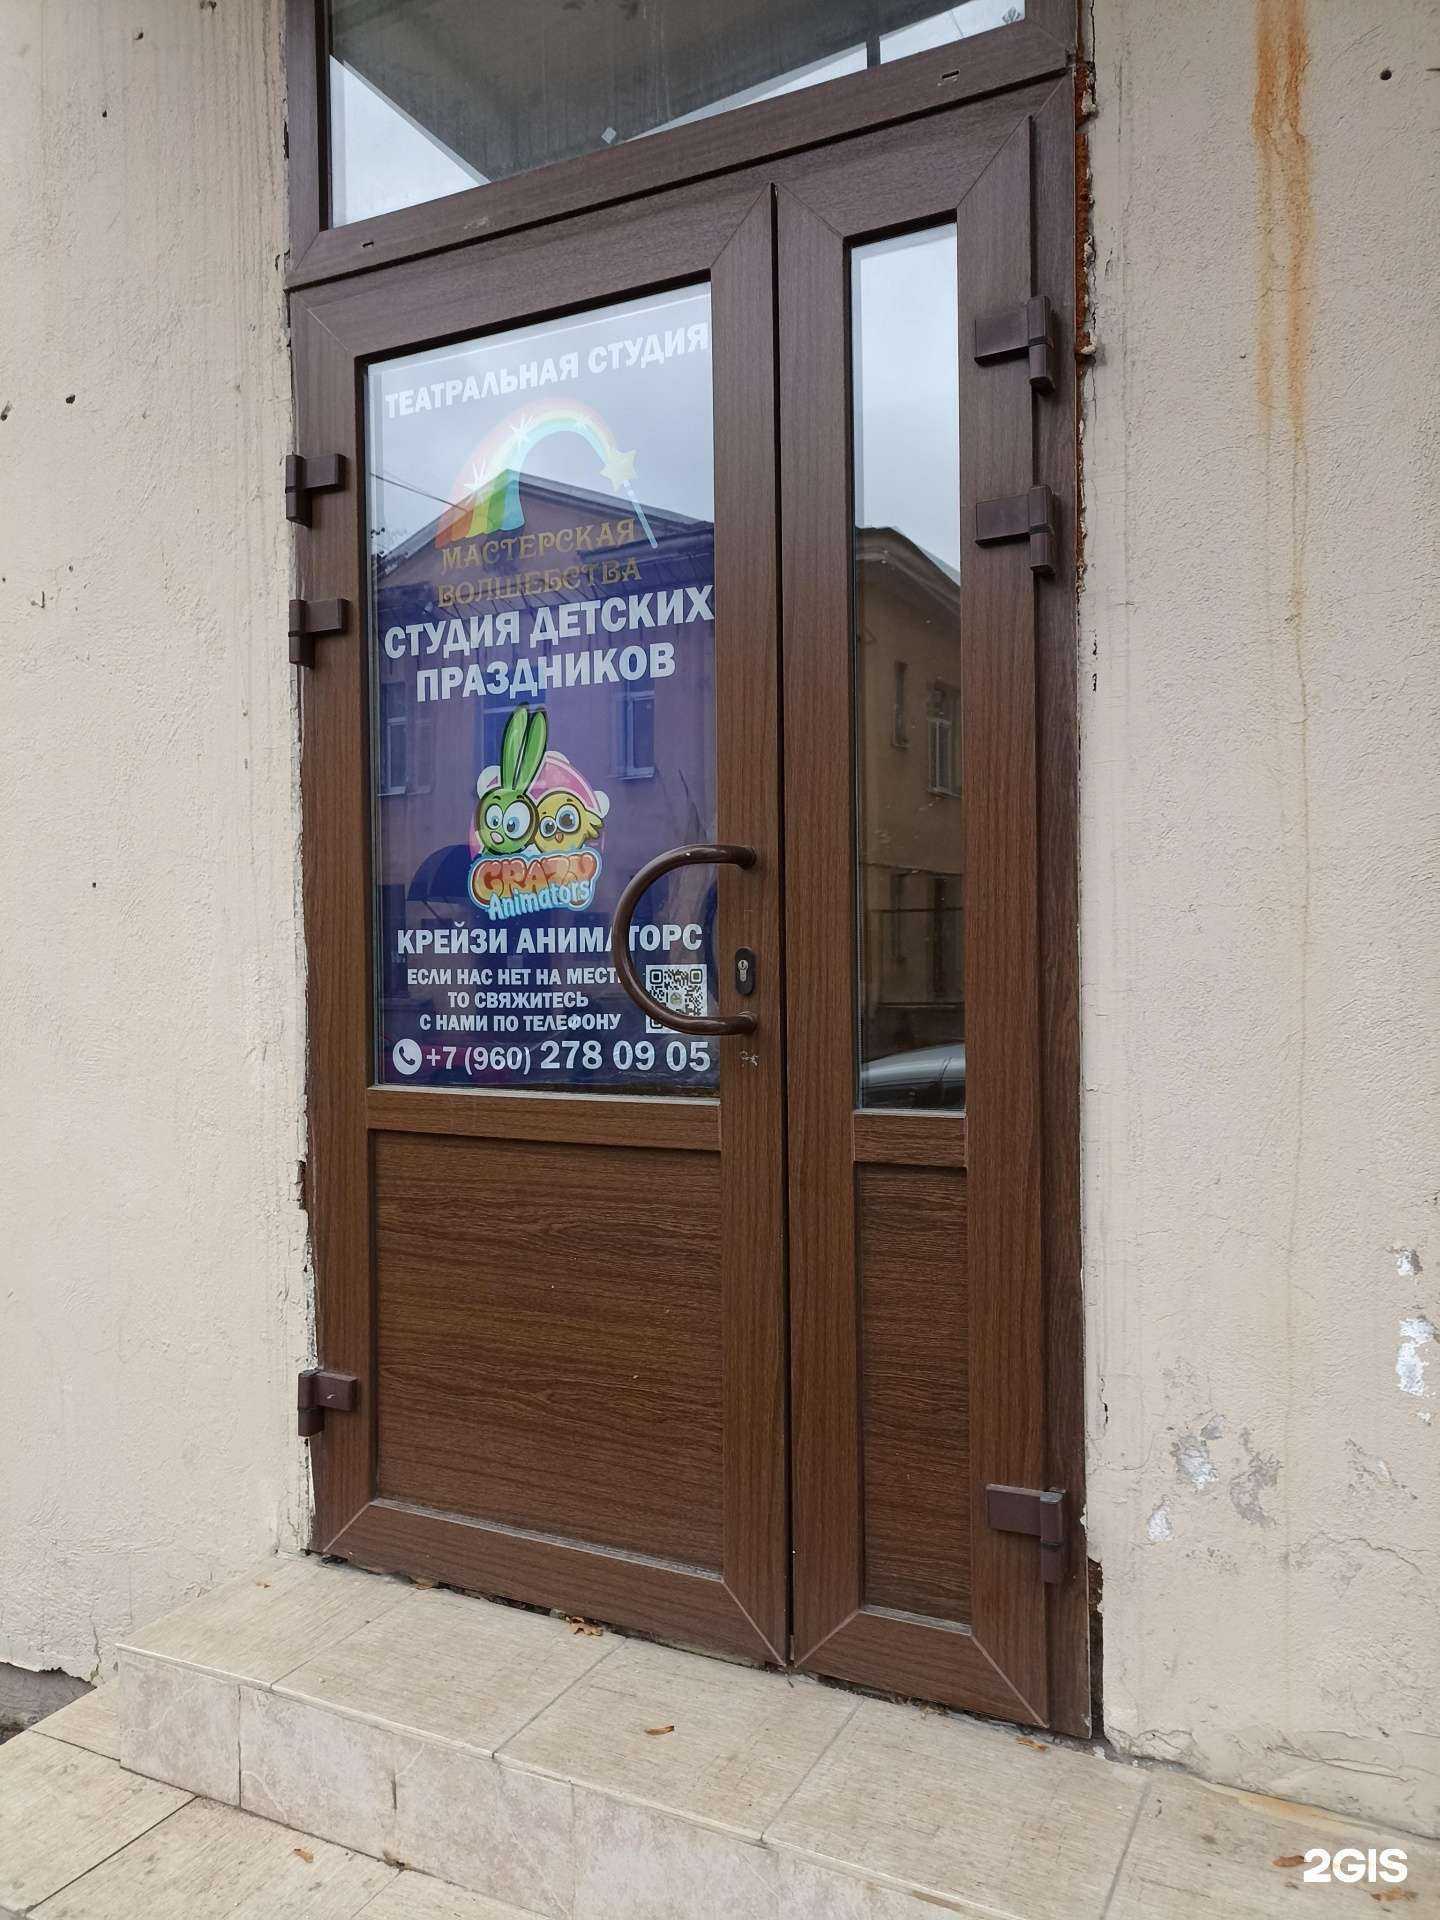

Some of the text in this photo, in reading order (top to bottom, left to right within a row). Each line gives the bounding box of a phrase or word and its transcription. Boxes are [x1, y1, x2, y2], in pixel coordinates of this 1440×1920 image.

[385, 322, 710, 418] ТЕАТРАЛЬНАЯ СТУДИЯ
[441, 518, 635, 575] МАСТЕРСКАЯ
[438, 557, 642, 608] ВОЛШЕБСТВА
[384, 585, 714, 659] СТУДИЯ ДЕТСКИХ
[416, 642, 675, 702] ПРАЗДНИКОВ
[488, 880, 591, 920] Animators
[397, 921, 510, 954] КРЕЙЗИ
[407, 967, 622, 985] ЕСЛИ НАС НЕТ НА МЕСТ
[448, 991, 589, 1009] ТО СВЯЖИТЕСЬ
[419, 1013, 621, 1031] С НАМИ ПО ТЕЛЕФОНУ
[426, 1040, 711, 1074] +7 (960) 278 09 05
